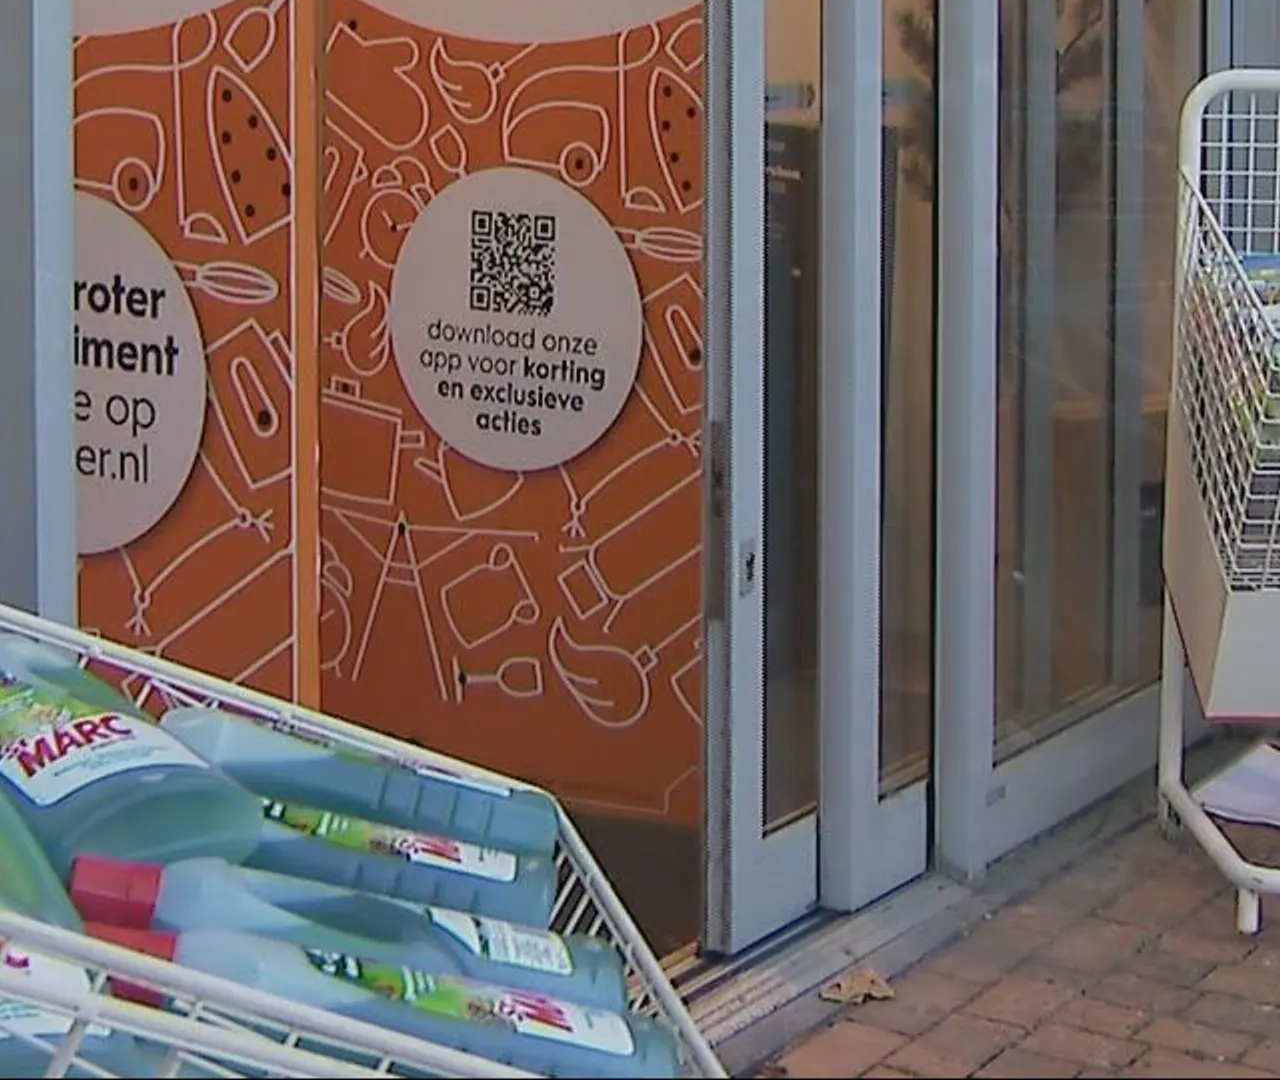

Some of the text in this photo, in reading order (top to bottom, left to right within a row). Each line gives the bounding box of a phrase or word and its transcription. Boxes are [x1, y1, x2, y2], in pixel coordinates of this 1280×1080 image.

[74, 273, 166, 320] roter
[74, 325, 179, 377] iment
[427, 319, 598, 357] download onze
[419, 349, 606, 392] app voor korting
[104, 393, 157, 437] op
[437, 378, 585, 413] en exclusieve
[475, 410, 543, 438] acties
[75, 442, 151, 484] er.nl
[12, 714, 133, 779] MARC
